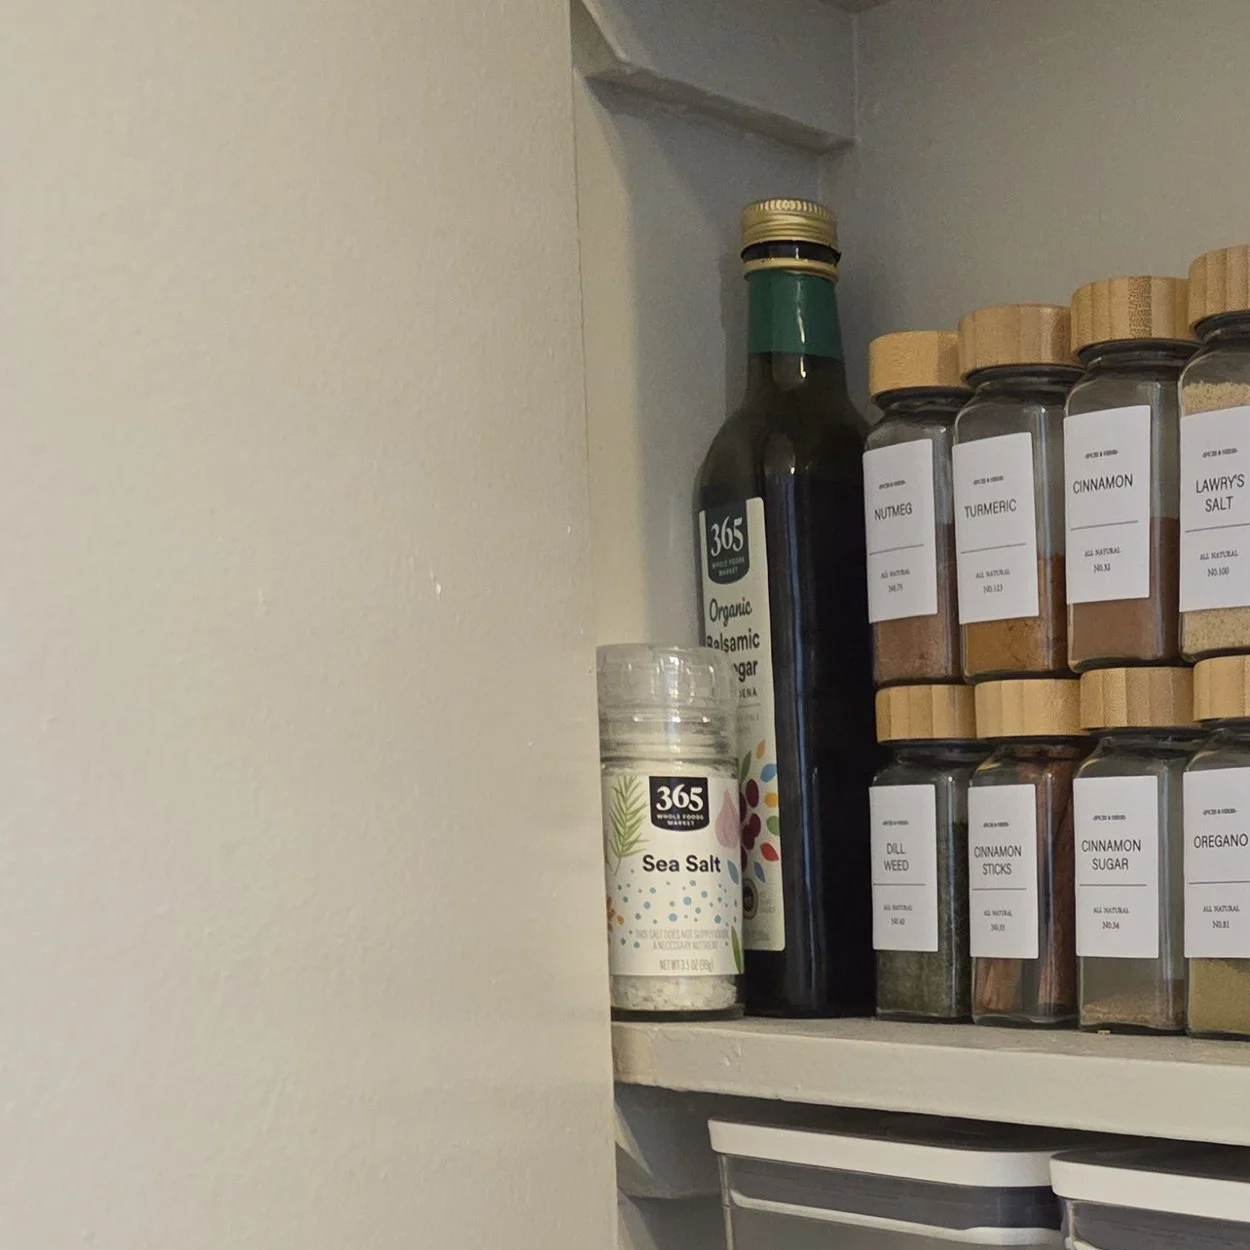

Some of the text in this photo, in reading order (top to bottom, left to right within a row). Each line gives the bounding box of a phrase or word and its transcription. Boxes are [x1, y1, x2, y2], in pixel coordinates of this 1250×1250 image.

[1073, 474, 1133, 494] CINNAMON
[1196, 474, 1245, 494] LAWRY'S
[874, 502, 913, 520] NUTMEG
[964, 499, 1016, 519] TURMERIC
[1205, 496, 1233, 513] SALT
[710, 516, 744, 557] 365
[709, 597, 752, 627] Organic
[656, 784, 704, 812] 365
[886, 843, 906, 856] DILL
[1081, 839, 1141, 852] CINNAMON
[1193, 833, 1249, 849] OREGANO
[974, 845, 1022, 858] CINNAMON
[642, 855, 721, 874] Sea Salt
[884, 858, 909, 872] WEED
[982, 862, 1012, 875] STICKS
[1092, 858, 1129, 871] SUGAR
